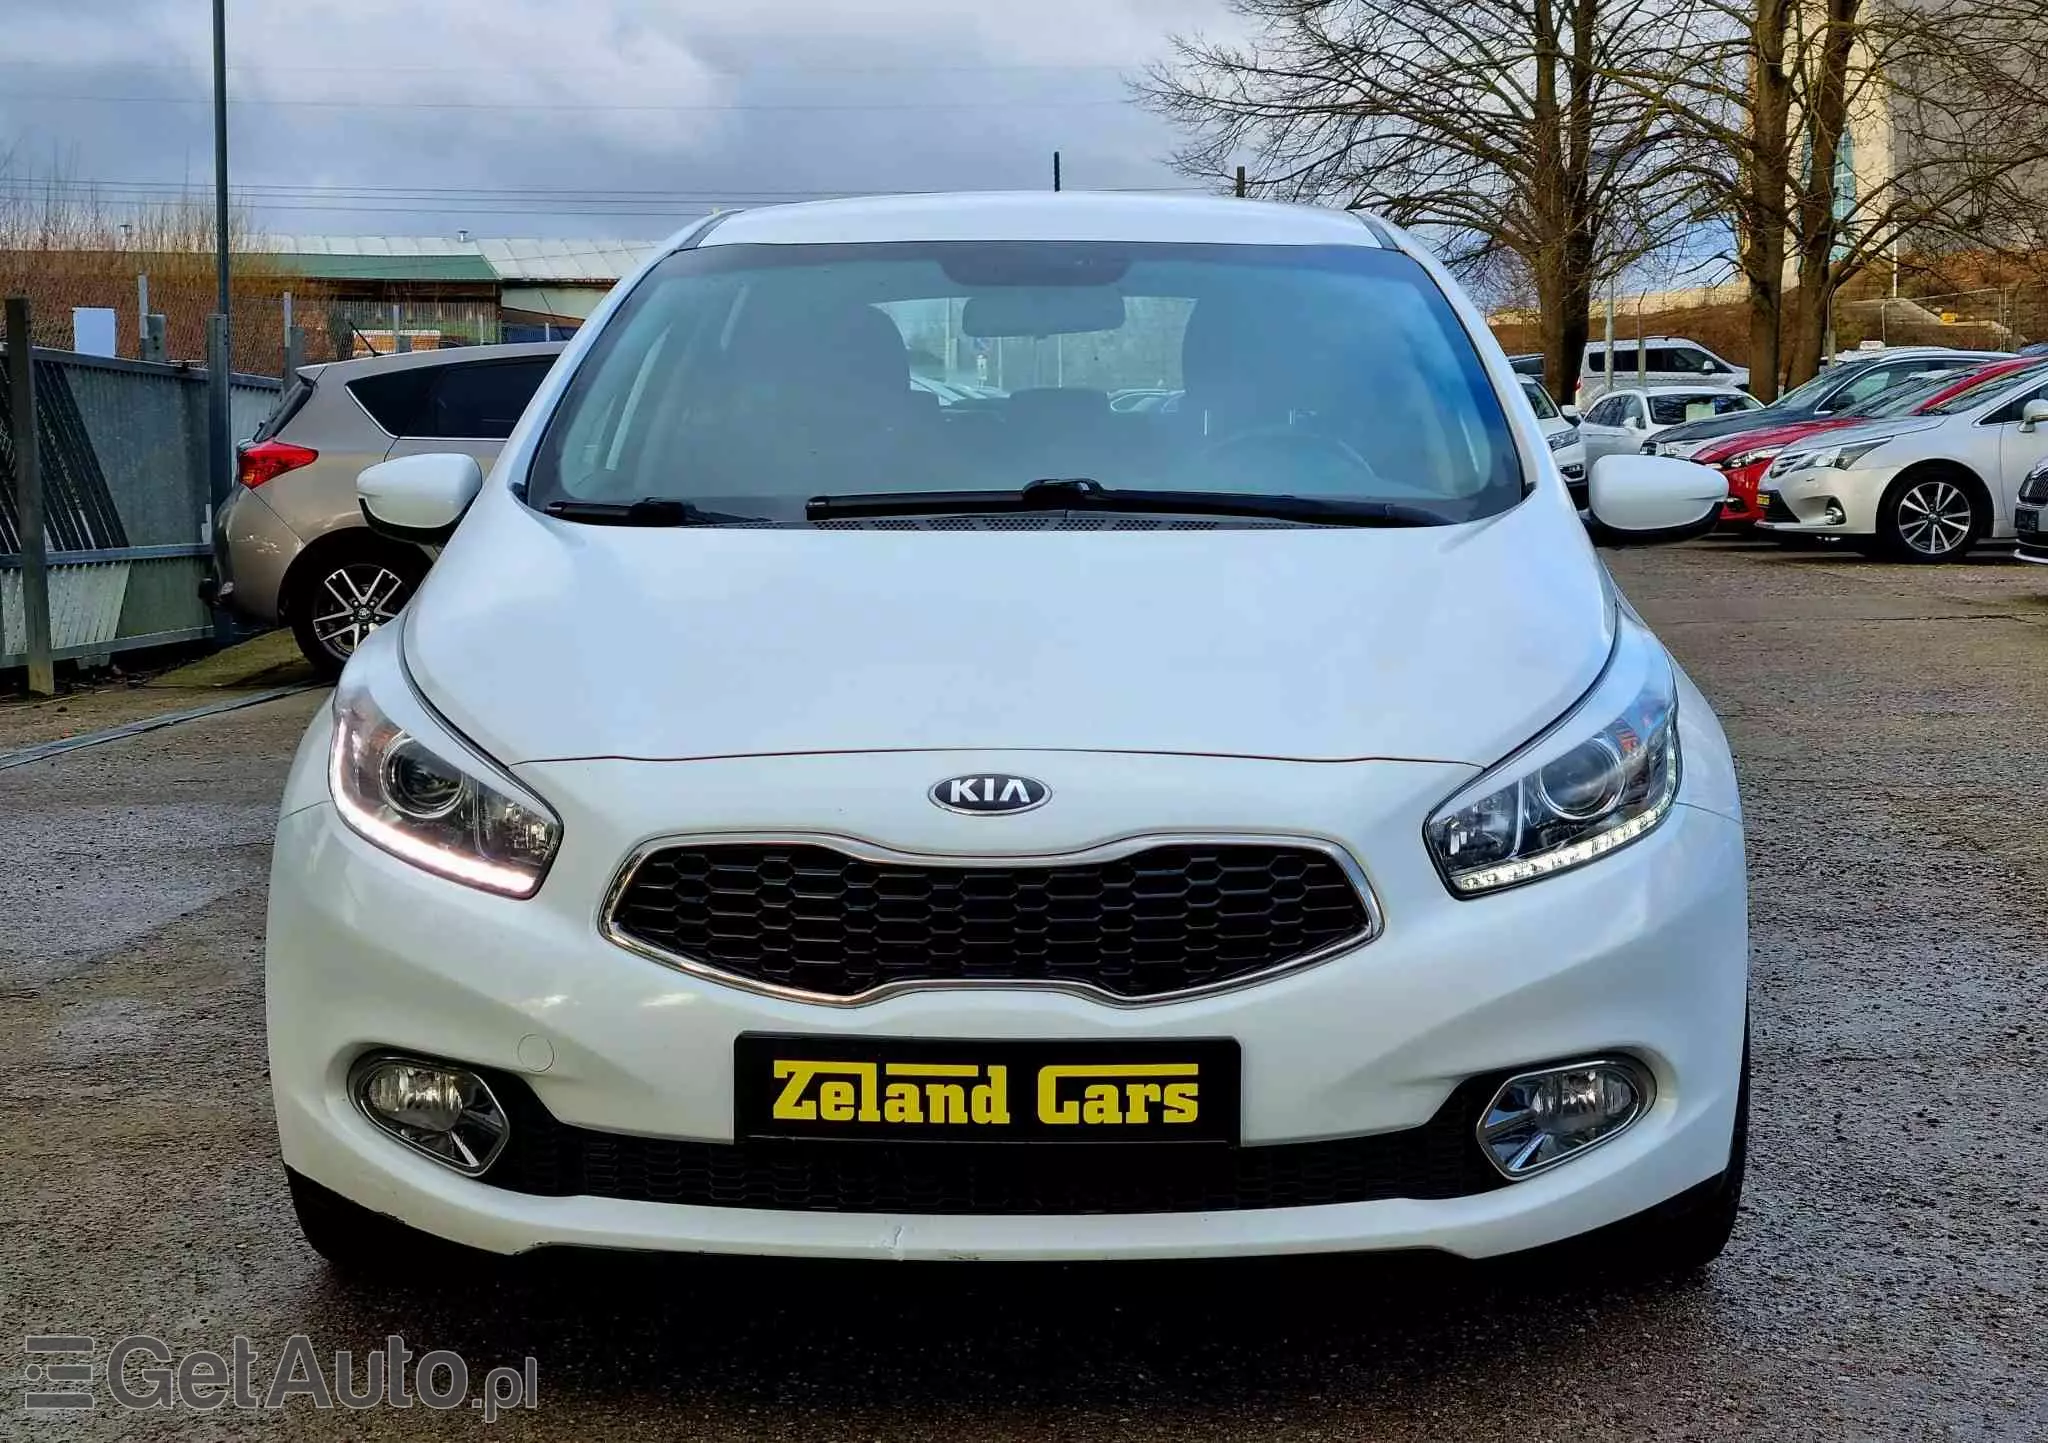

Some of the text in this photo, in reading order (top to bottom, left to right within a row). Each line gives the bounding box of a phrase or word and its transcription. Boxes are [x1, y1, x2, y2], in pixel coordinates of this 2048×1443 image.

[949, 778, 1031, 803] KIA
[773, 1059, 1199, 1124] Zeland Cars
